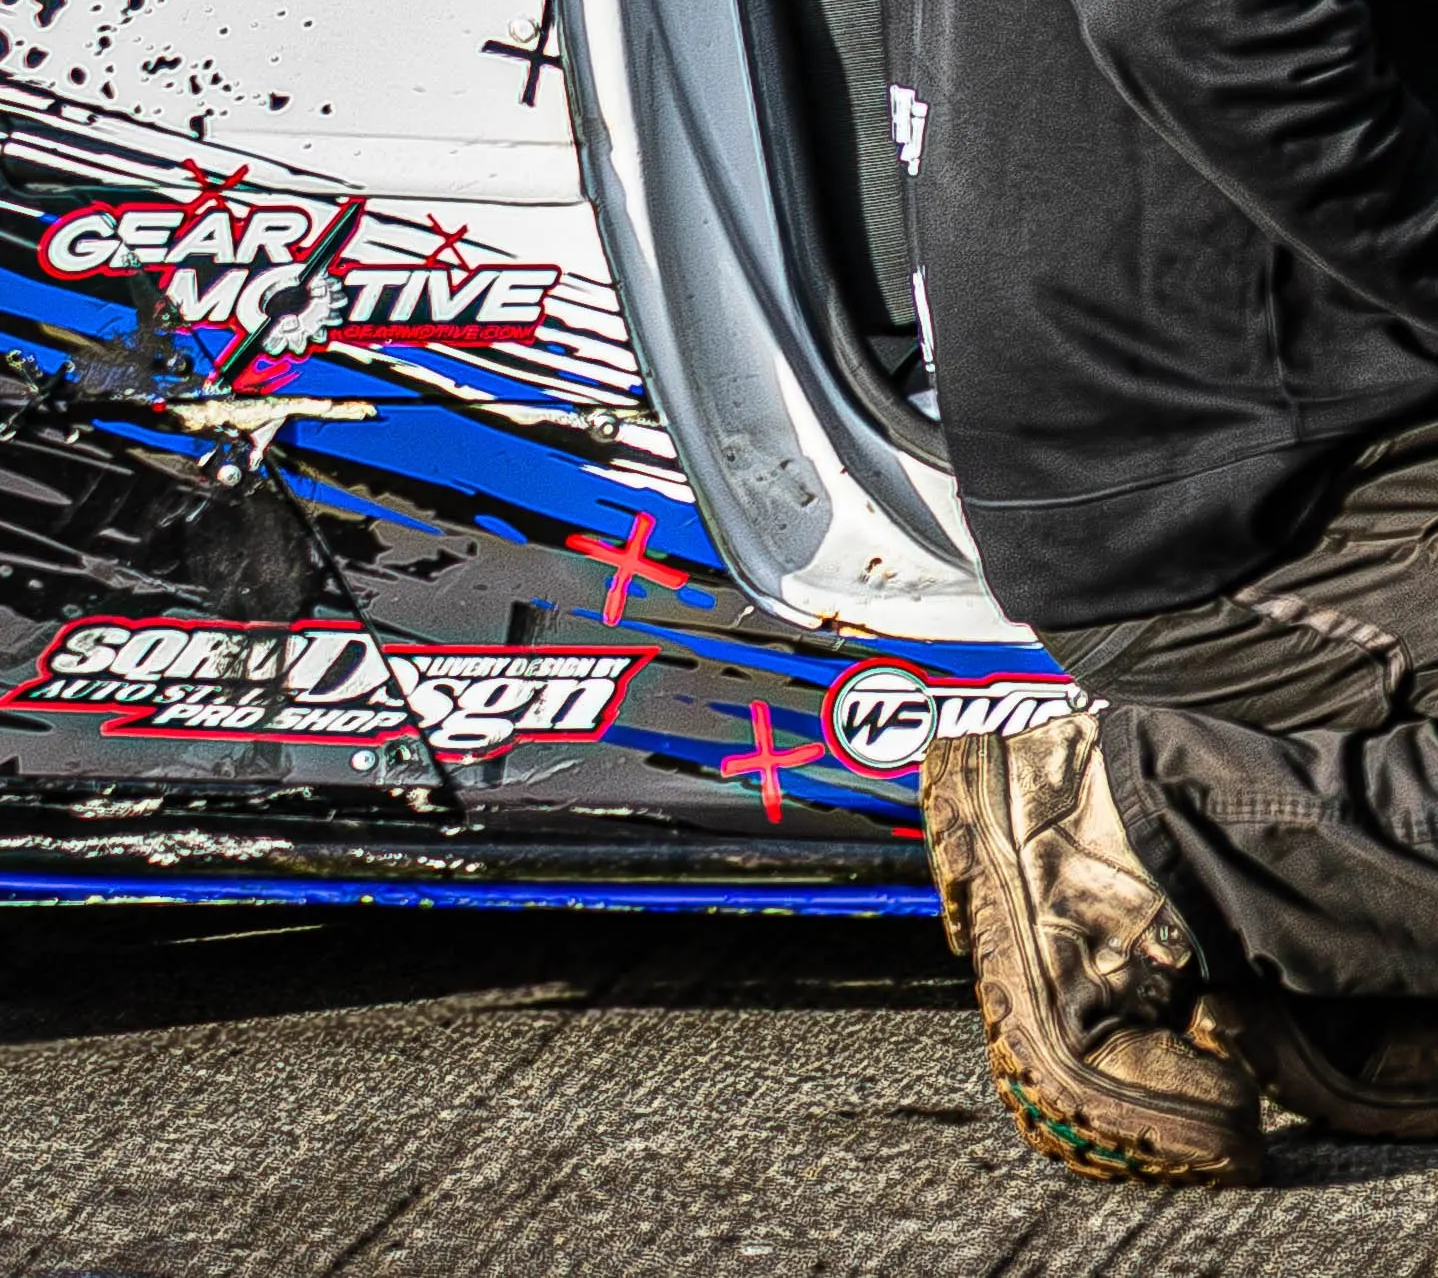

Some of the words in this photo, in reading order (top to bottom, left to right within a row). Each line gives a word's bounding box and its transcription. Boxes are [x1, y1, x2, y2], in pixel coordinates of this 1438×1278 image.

[47, 210, 311, 272] GEAR
[38, 679, 158, 703] AUTO
[152, 704, 265, 729] PRO
[266, 707, 408, 734] SHOP
